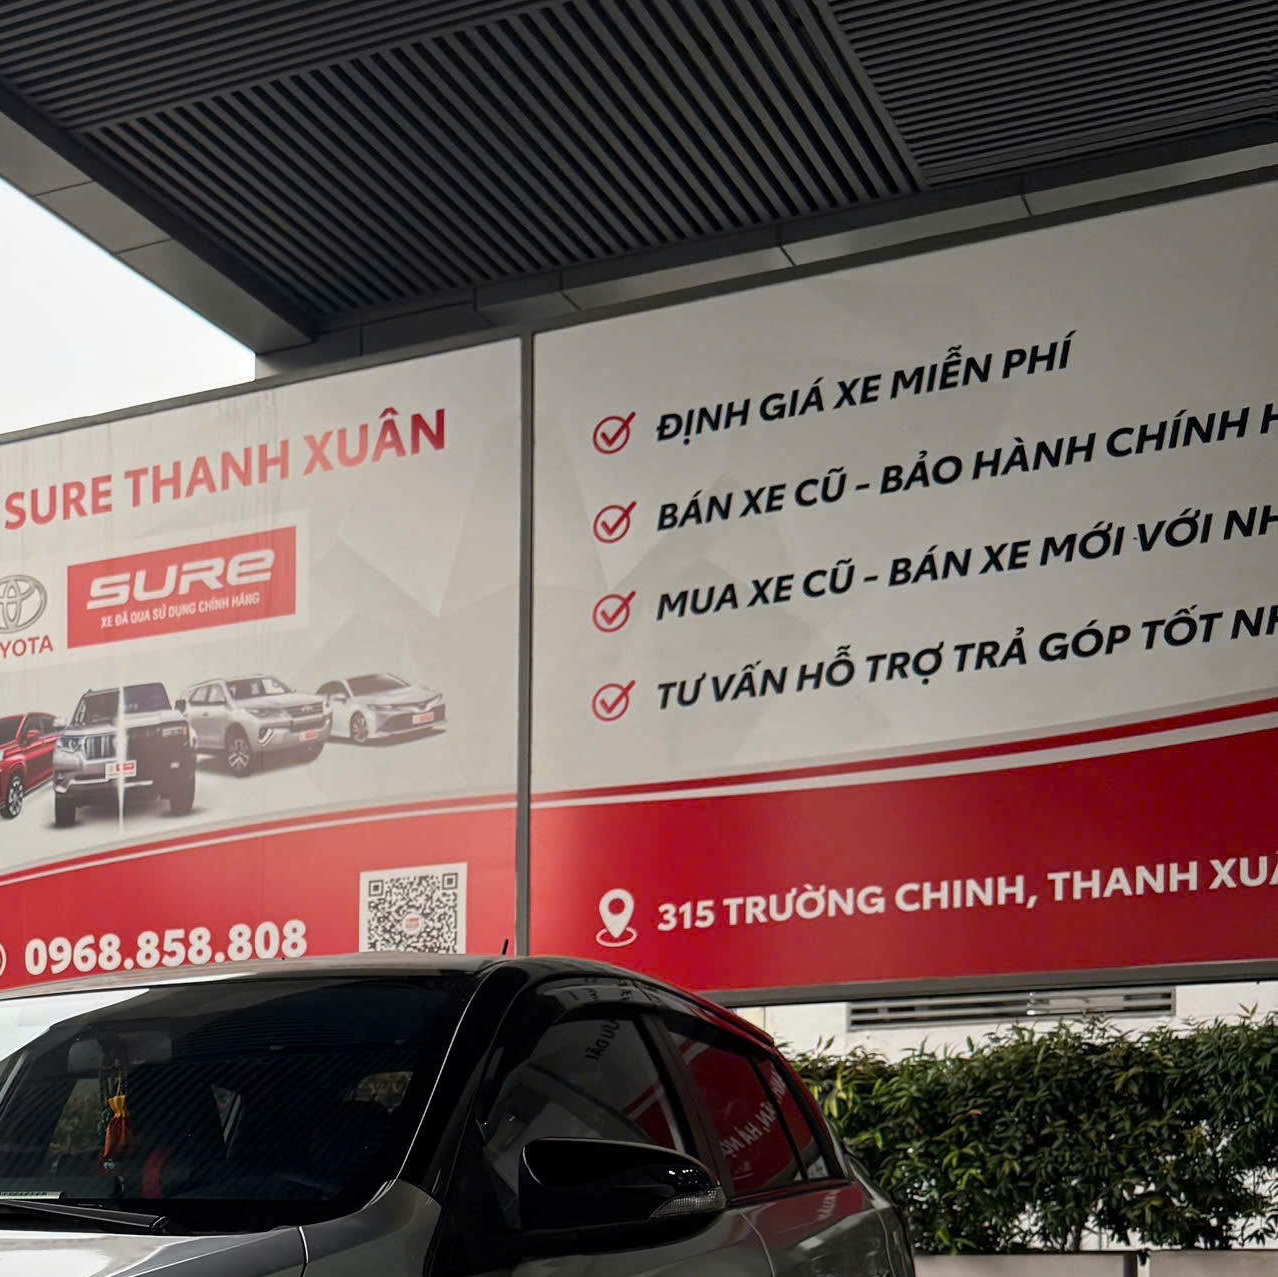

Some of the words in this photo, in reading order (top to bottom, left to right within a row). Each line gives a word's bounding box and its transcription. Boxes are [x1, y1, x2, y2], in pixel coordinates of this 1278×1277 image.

[656, 398, 751, 446] ĐỊNH
[758, 376, 825, 422] GIÁ
[833, 373, 882, 410] XE
[890, 344, 993, 399] MIỄN
[1001, 330, 1078, 379] PHÍ
[3, 473, 113, 531] SURE
[124, 440, 289, 508] THANH
[302, 406, 447, 477] XUÂN
[657, 490, 733, 531] BÁN
[739, 483, 787, 518] XE
[794, 466, 848, 507] CŨ
[880, 450, 963, 496] BẢO
[971, 432, 1097, 481] HÀNH
[1106, 406, 1250, 458] CHÍNH
[86, 549, 275, 611] SURE
[100, 614, 113, 629] XE
[130, 610, 151, 625] QUA
[168, 601, 197, 620] DỤNG
[198, 596, 230, 613] CHÍNH
[656, 582, 740, 622] MUA
[747, 573, 795, 608] XE
[802, 558, 856, 598] CŨ
[888, 545, 972, 588] BÁN
[979, 540, 1031, 575] XE
[1039, 520, 1125, 567] MỚI
[1137, 507, 1213, 552] VỚI
[657, 672, 707, 711] TƯ
[711, 660, 788, 703] VẤN
[795, 644, 855, 693] HỖ
[865, 641, 945, 686] TRỢ
[953, 627, 1028, 673] TRẢ
[1038, 619, 1131, 663] GÓP
[1141, 604, 1224, 650] TỐT
[25, 919, 308, 977] 0968.858.808
[657, 899, 715, 932] 315
[723, 882, 886, 926] TRƯỜNG
[894, 874, 1038, 912] CHINH,
[1047, 860, 1198, 902] THANH
